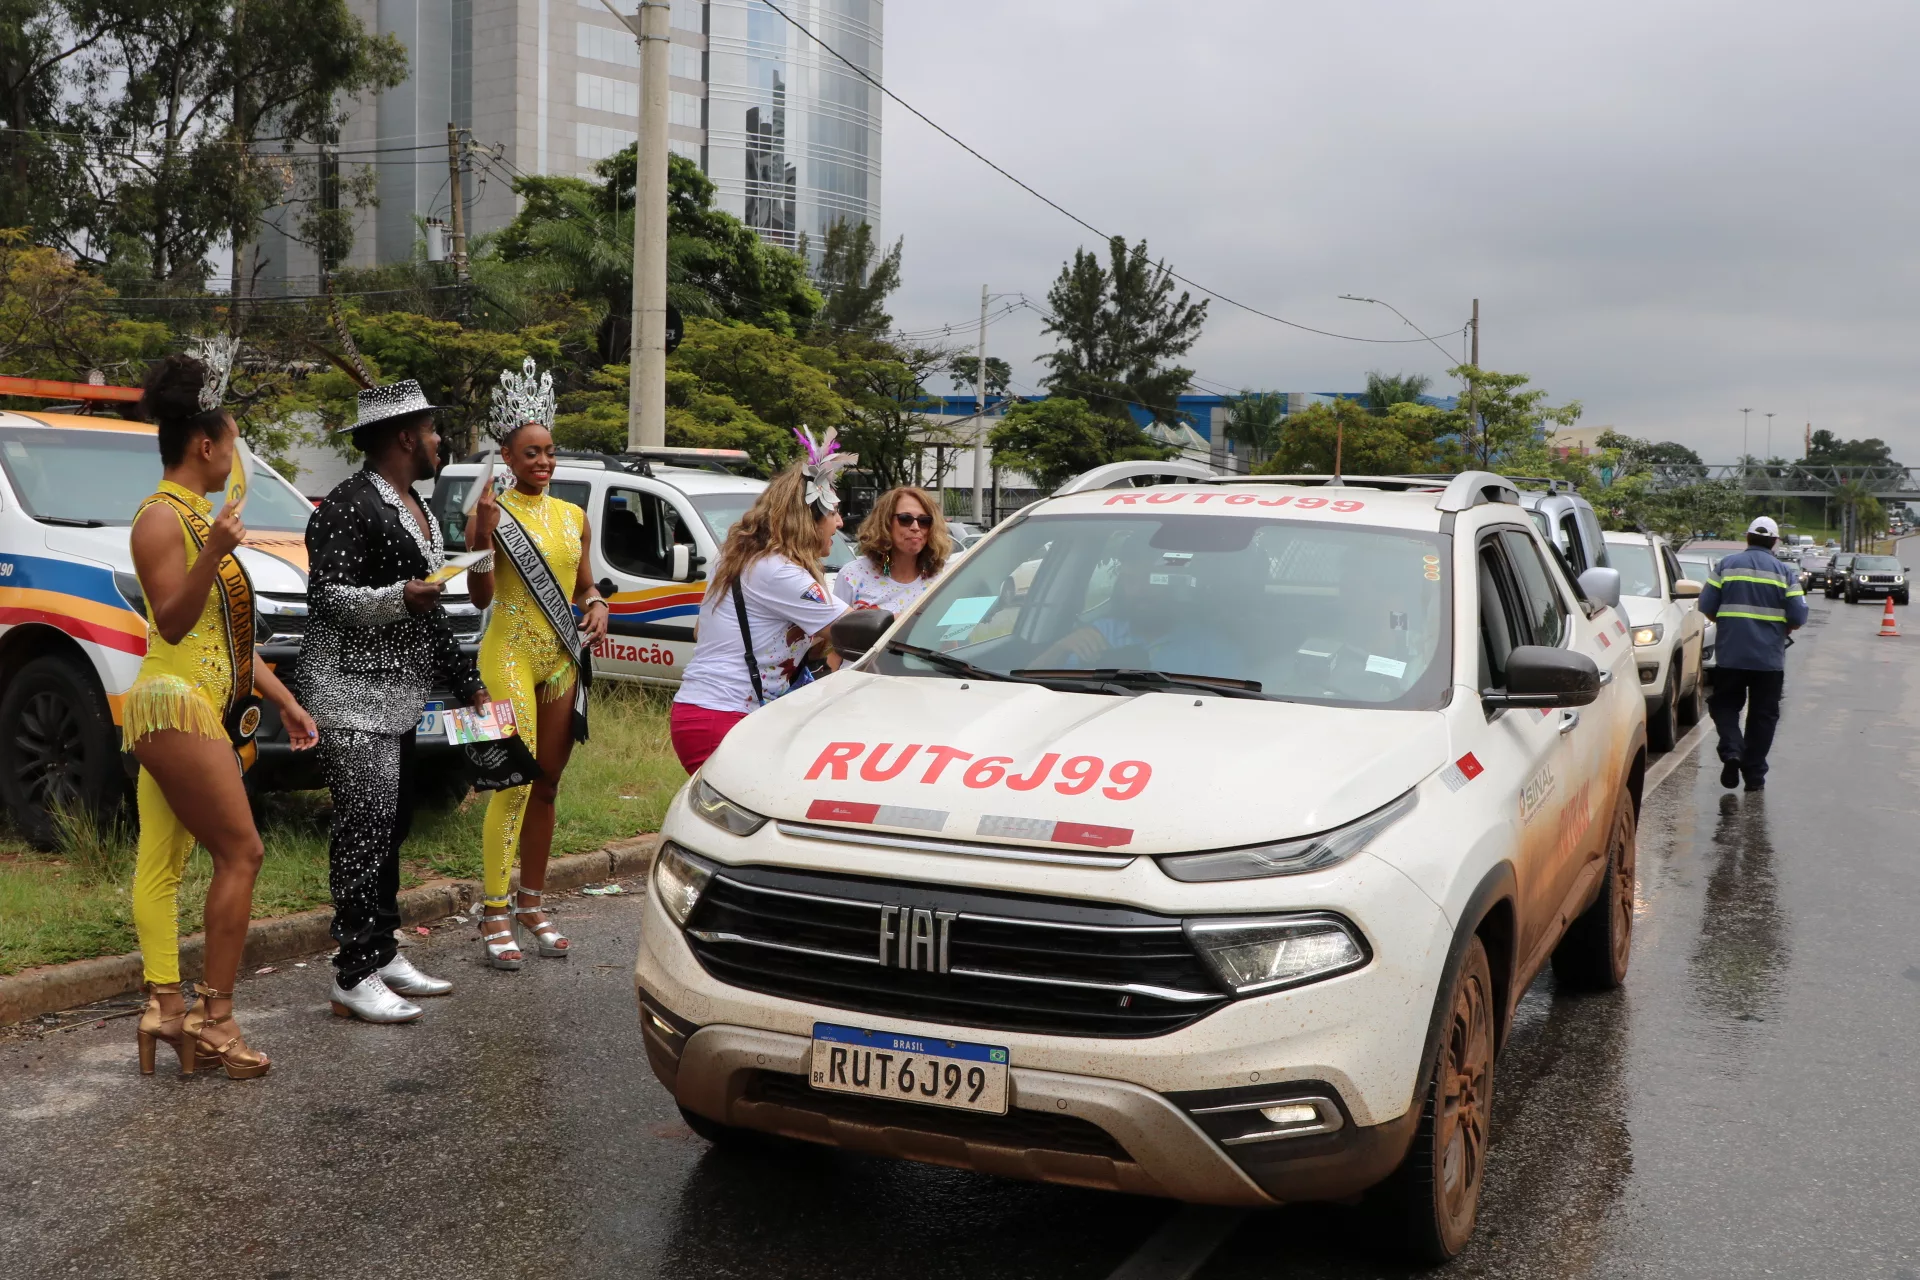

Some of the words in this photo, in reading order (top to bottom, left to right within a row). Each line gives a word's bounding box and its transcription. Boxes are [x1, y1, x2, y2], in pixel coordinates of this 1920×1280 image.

[1102, 493, 1365, 513] RUT6J99
[226, 572, 247, 598] DO
[500, 522, 540, 575] PRINCESA
[531, 573, 550, 591] DO
[542, 588, 574, 638] CARNAVAL
[803, 741, 1152, 801] RUT6J99
[1525, 763, 1554, 812] SINAL
[880, 904, 957, 974] FIAT
[893, 1038, 925, 1052] BRASIL
[813, 1071, 824, 1083] BR
[829, 1046, 986, 1103] RUT6J99
